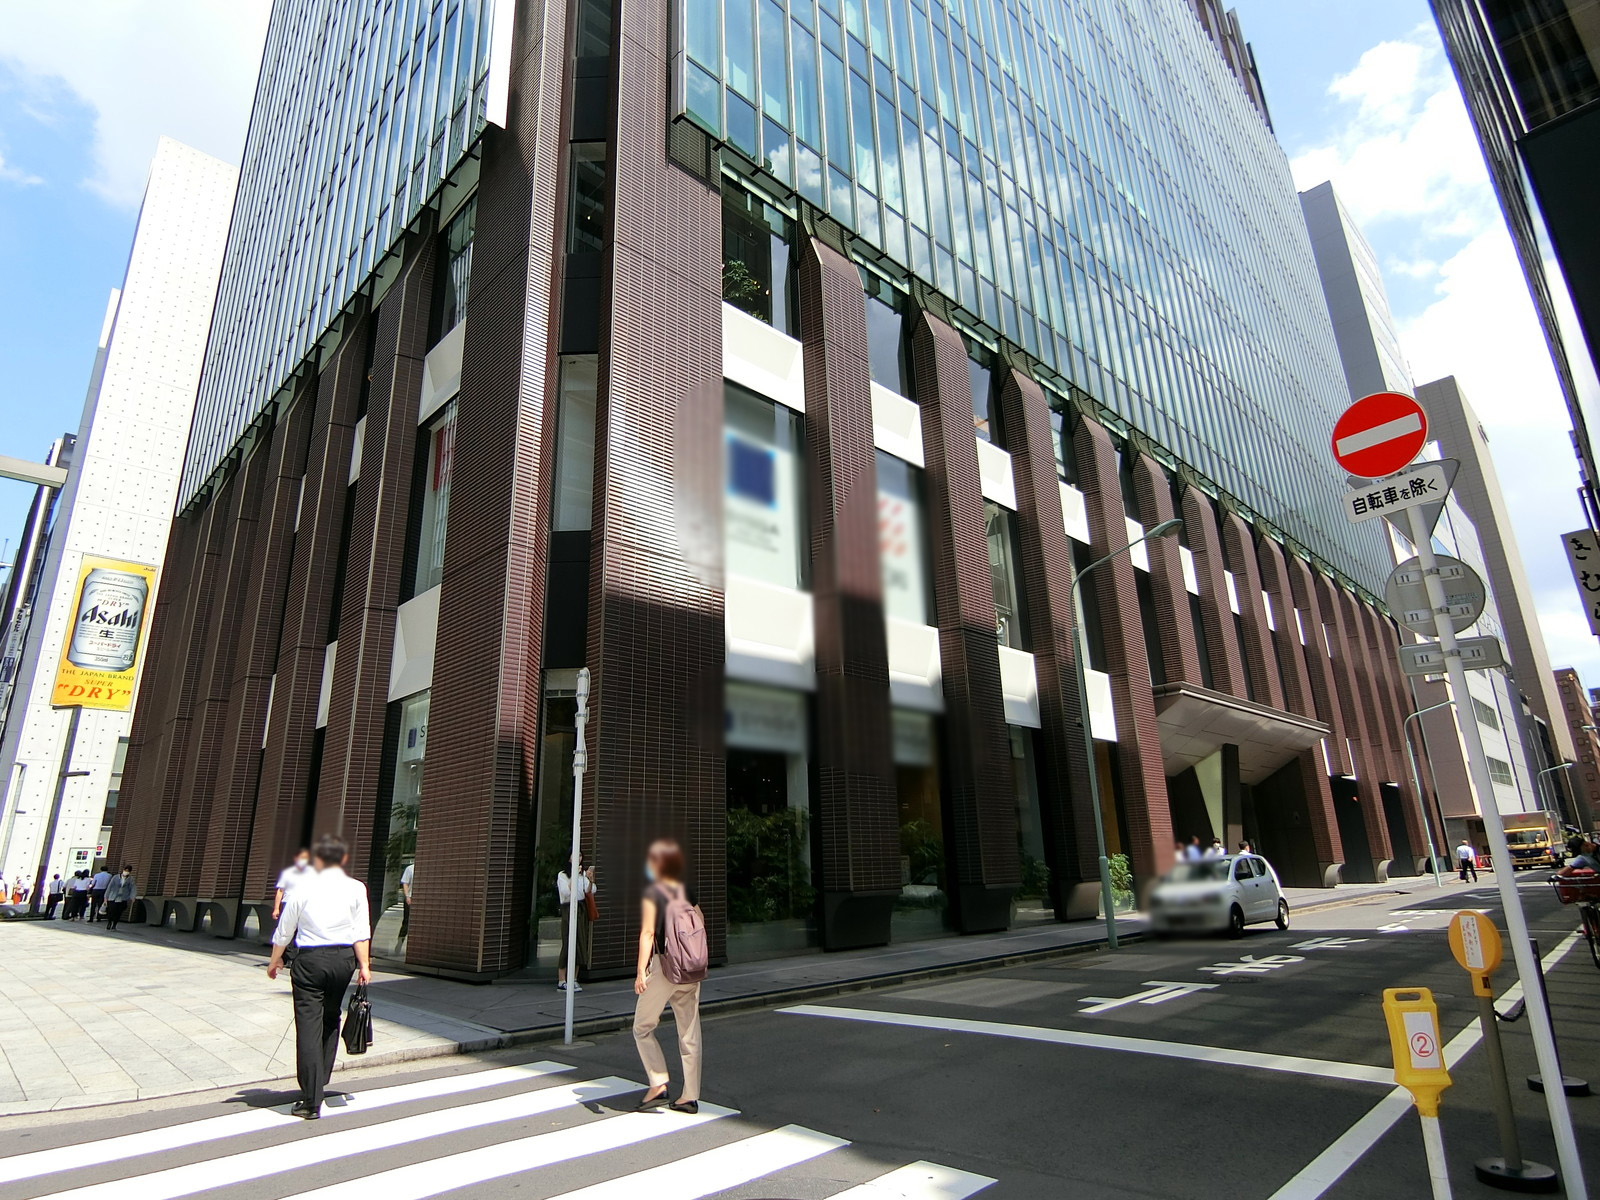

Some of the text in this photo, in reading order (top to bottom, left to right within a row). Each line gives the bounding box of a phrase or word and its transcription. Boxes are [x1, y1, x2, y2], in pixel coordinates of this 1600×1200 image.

[1352, 478, 1438, 515] 自転車を除く
[81, 605, 139, 629] Asahi
[99, 629, 114, 639] 生
[84, 679, 114, 687] SUPER
